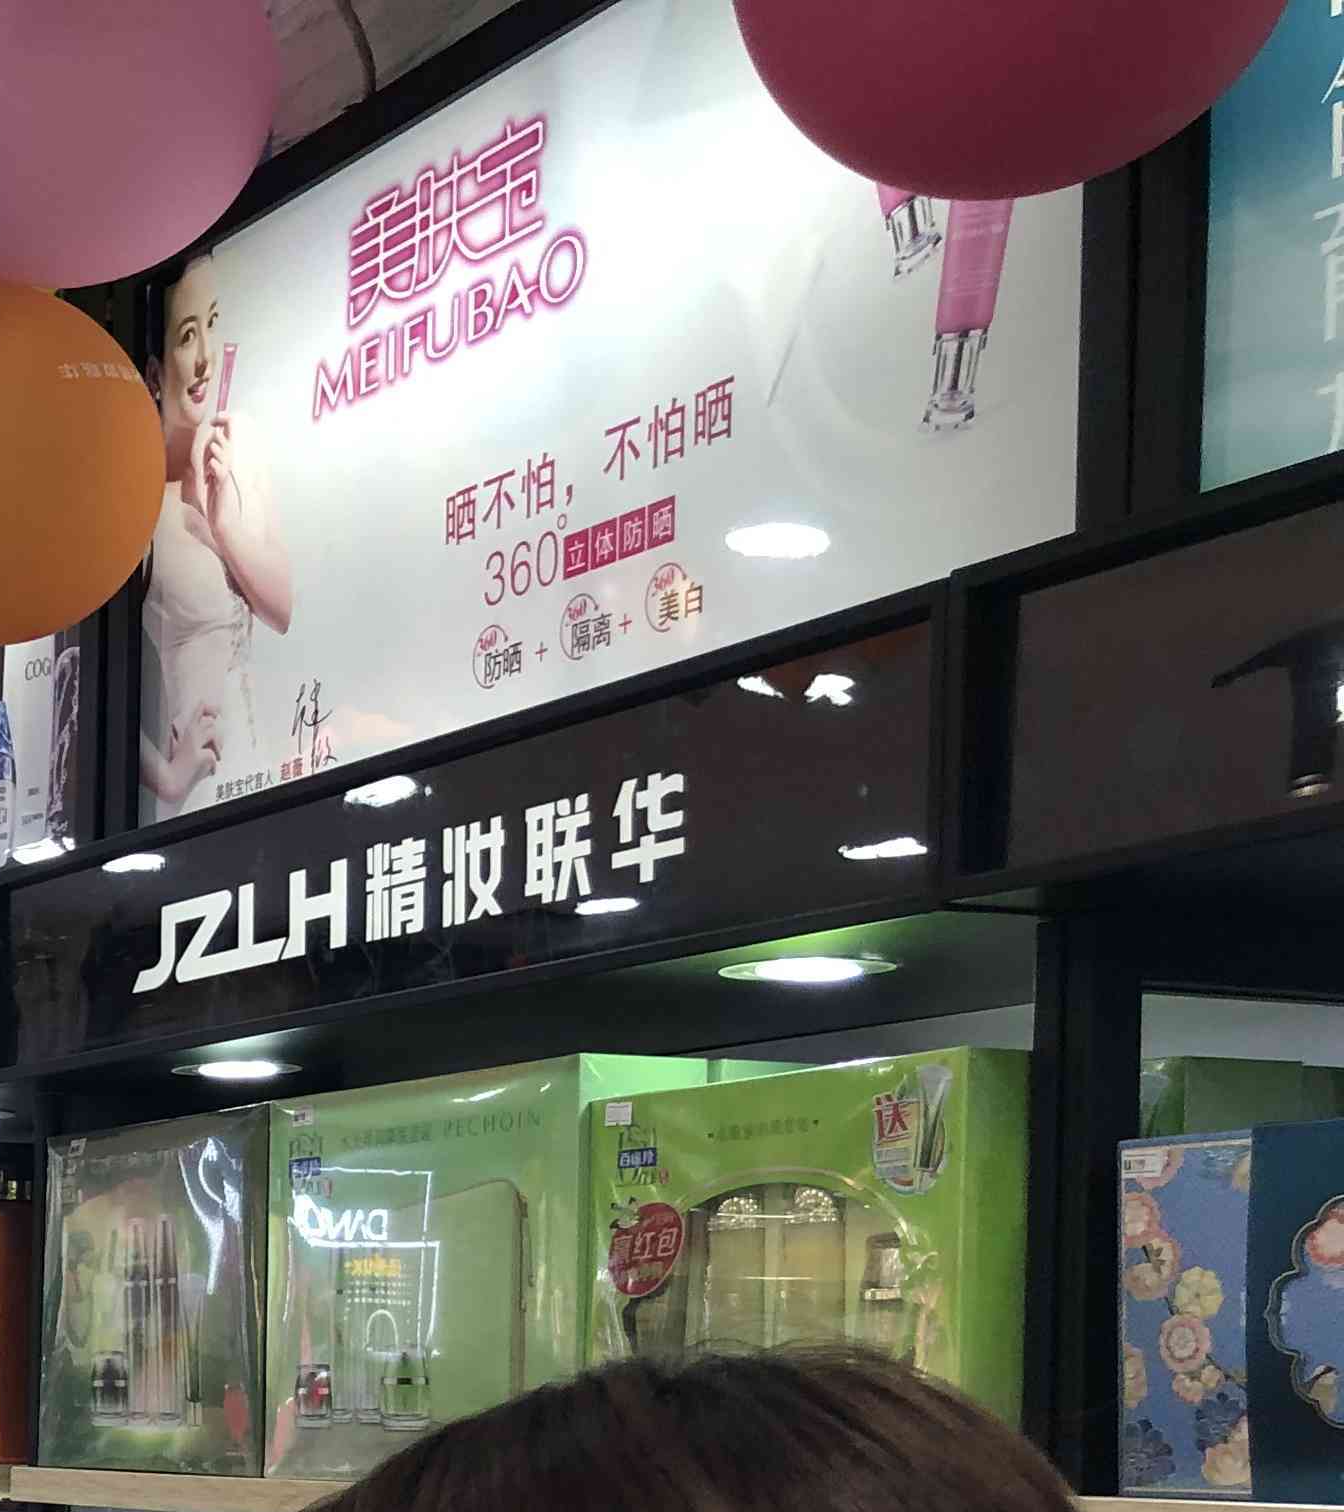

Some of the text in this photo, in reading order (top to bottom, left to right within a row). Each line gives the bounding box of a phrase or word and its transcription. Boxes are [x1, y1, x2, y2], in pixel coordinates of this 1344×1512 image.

[347, 113, 546, 327] 美肤宝
[313, 233, 587, 420] MEIFUBAO
[565, 501, 673, 576] 立体防晒
[483, 582, 704, 684] 防晒 隔离 美白
[216, 757, 304, 800] 美肤宝代言人 赵薇
[365, 772, 687, 943] 精妆联华
